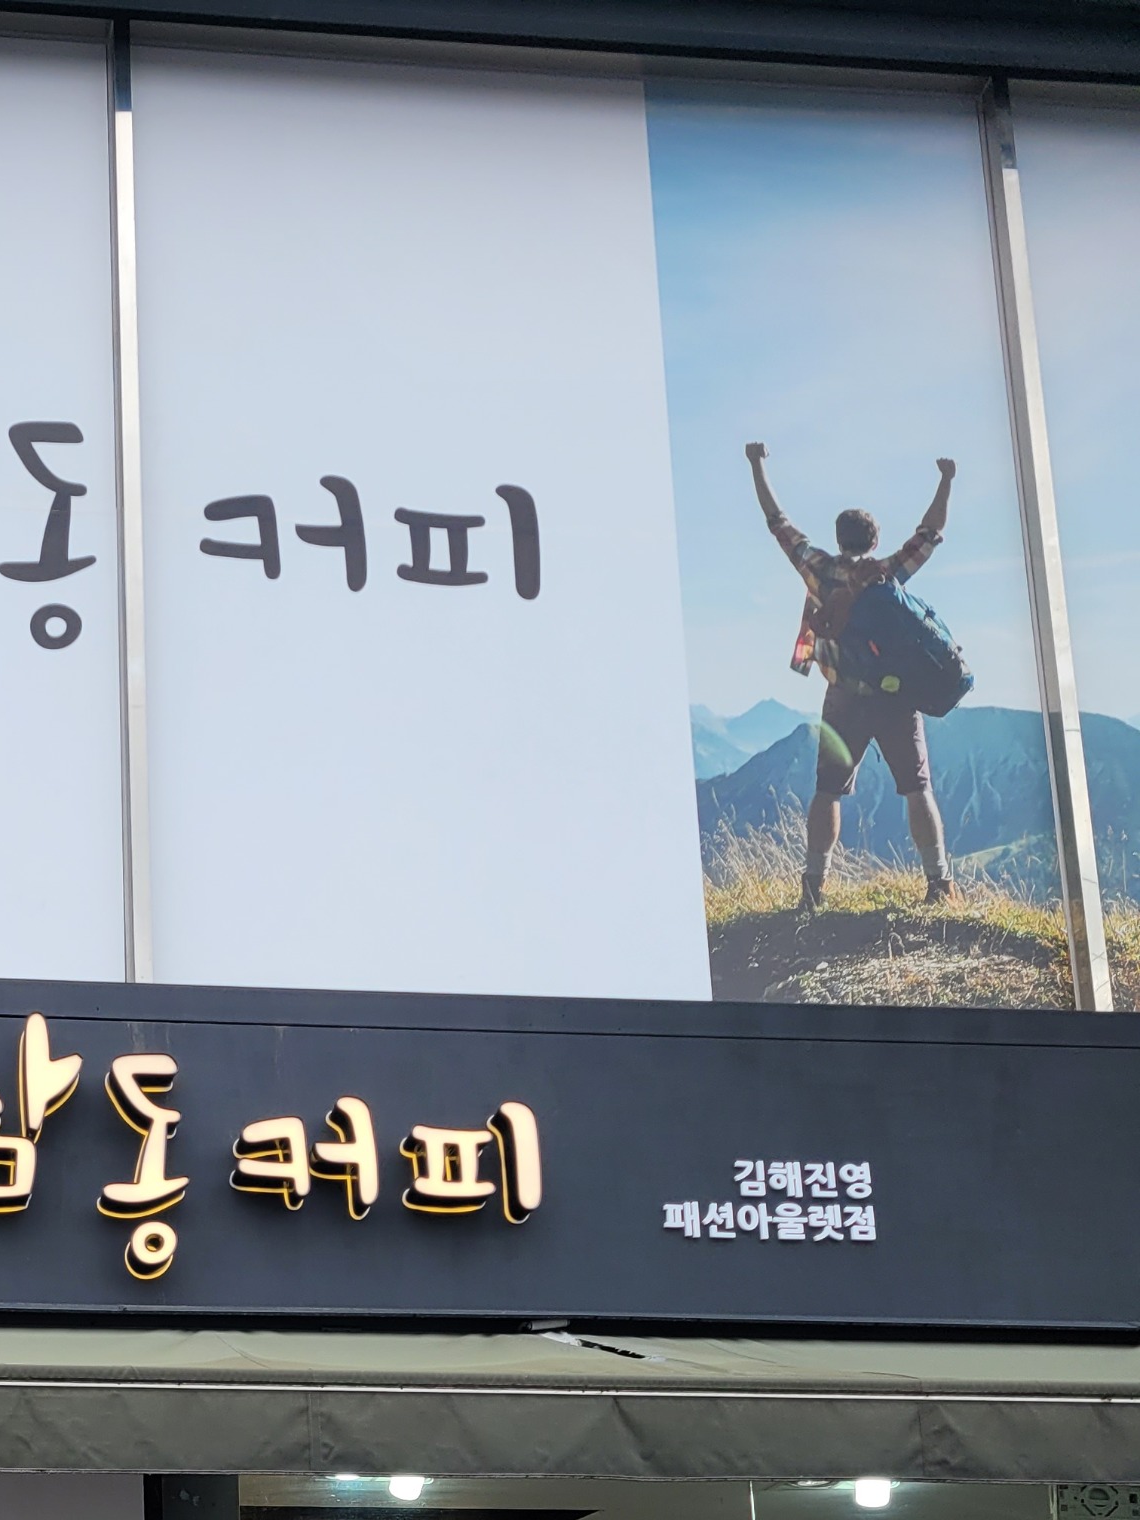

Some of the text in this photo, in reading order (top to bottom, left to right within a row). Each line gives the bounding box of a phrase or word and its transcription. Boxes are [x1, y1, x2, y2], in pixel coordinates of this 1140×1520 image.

[199, 475, 540, 600] 커피
[230, 1096, 543, 1225] 커피
[733, 1158, 872, 1199] 김해진영
[663, 1201, 877, 1242] 패션아울렛점
